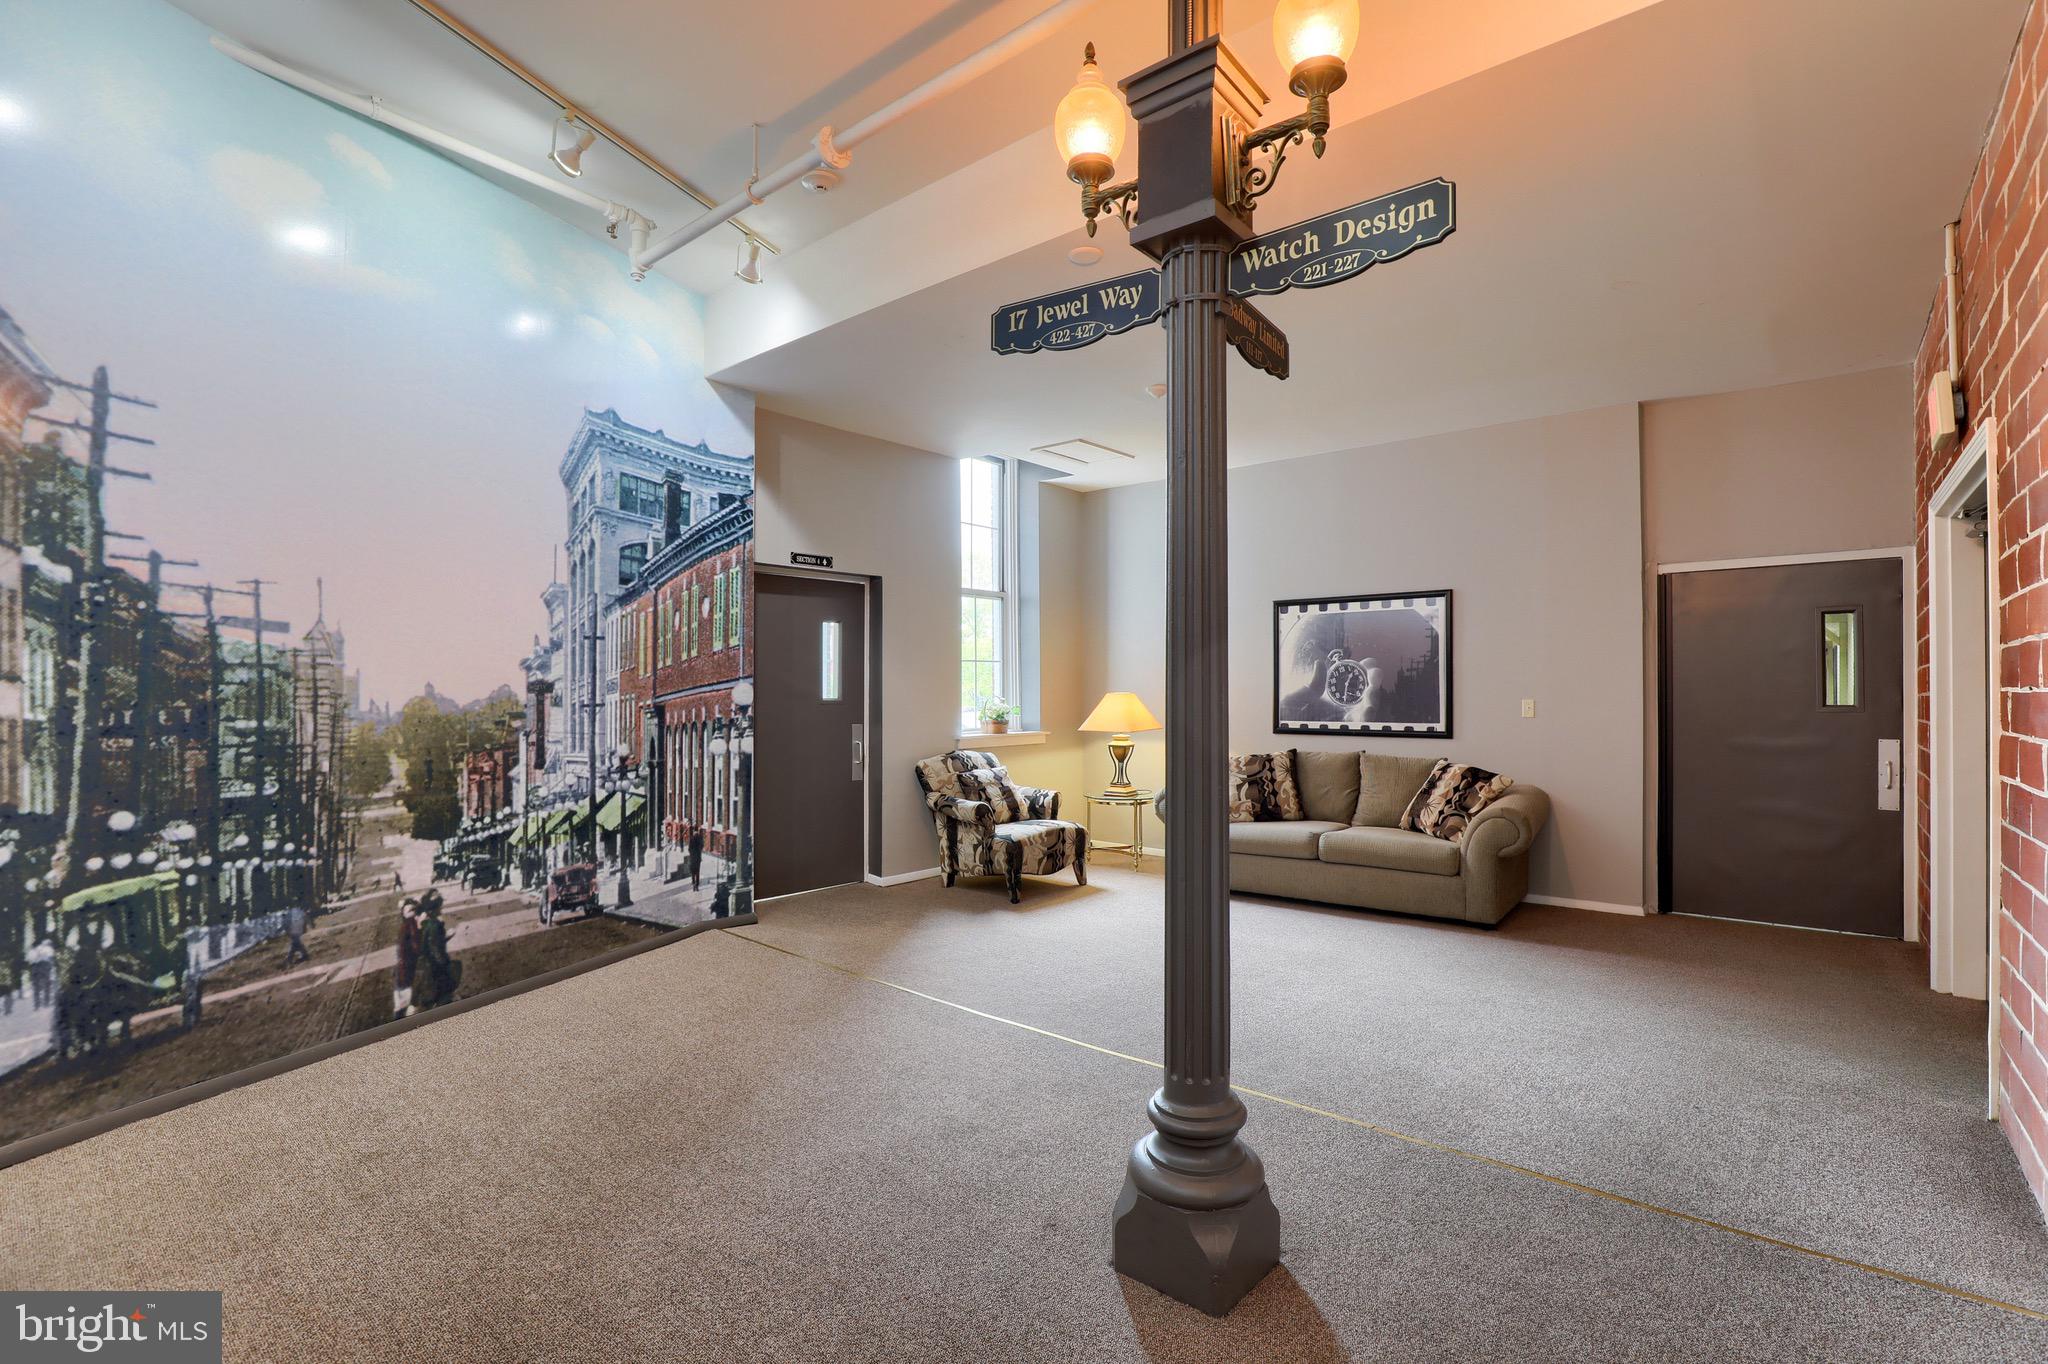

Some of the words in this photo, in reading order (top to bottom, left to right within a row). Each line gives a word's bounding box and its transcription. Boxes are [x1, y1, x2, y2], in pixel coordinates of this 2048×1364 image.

[1240, 230, 1321, 274] Watch
[1333, 198, 1437, 248] Design
[1302, 252, 1362, 283] 221-227
[1008, 308, 1028, 333] 17
[1036, 293, 1089, 329] Jewel
[1099, 284, 1143, 311] Way
[1049, 323, 1096, 345] 422-427
[1259, 321, 1285, 360] Limited
[796, 556, 817, 564] SECTION
